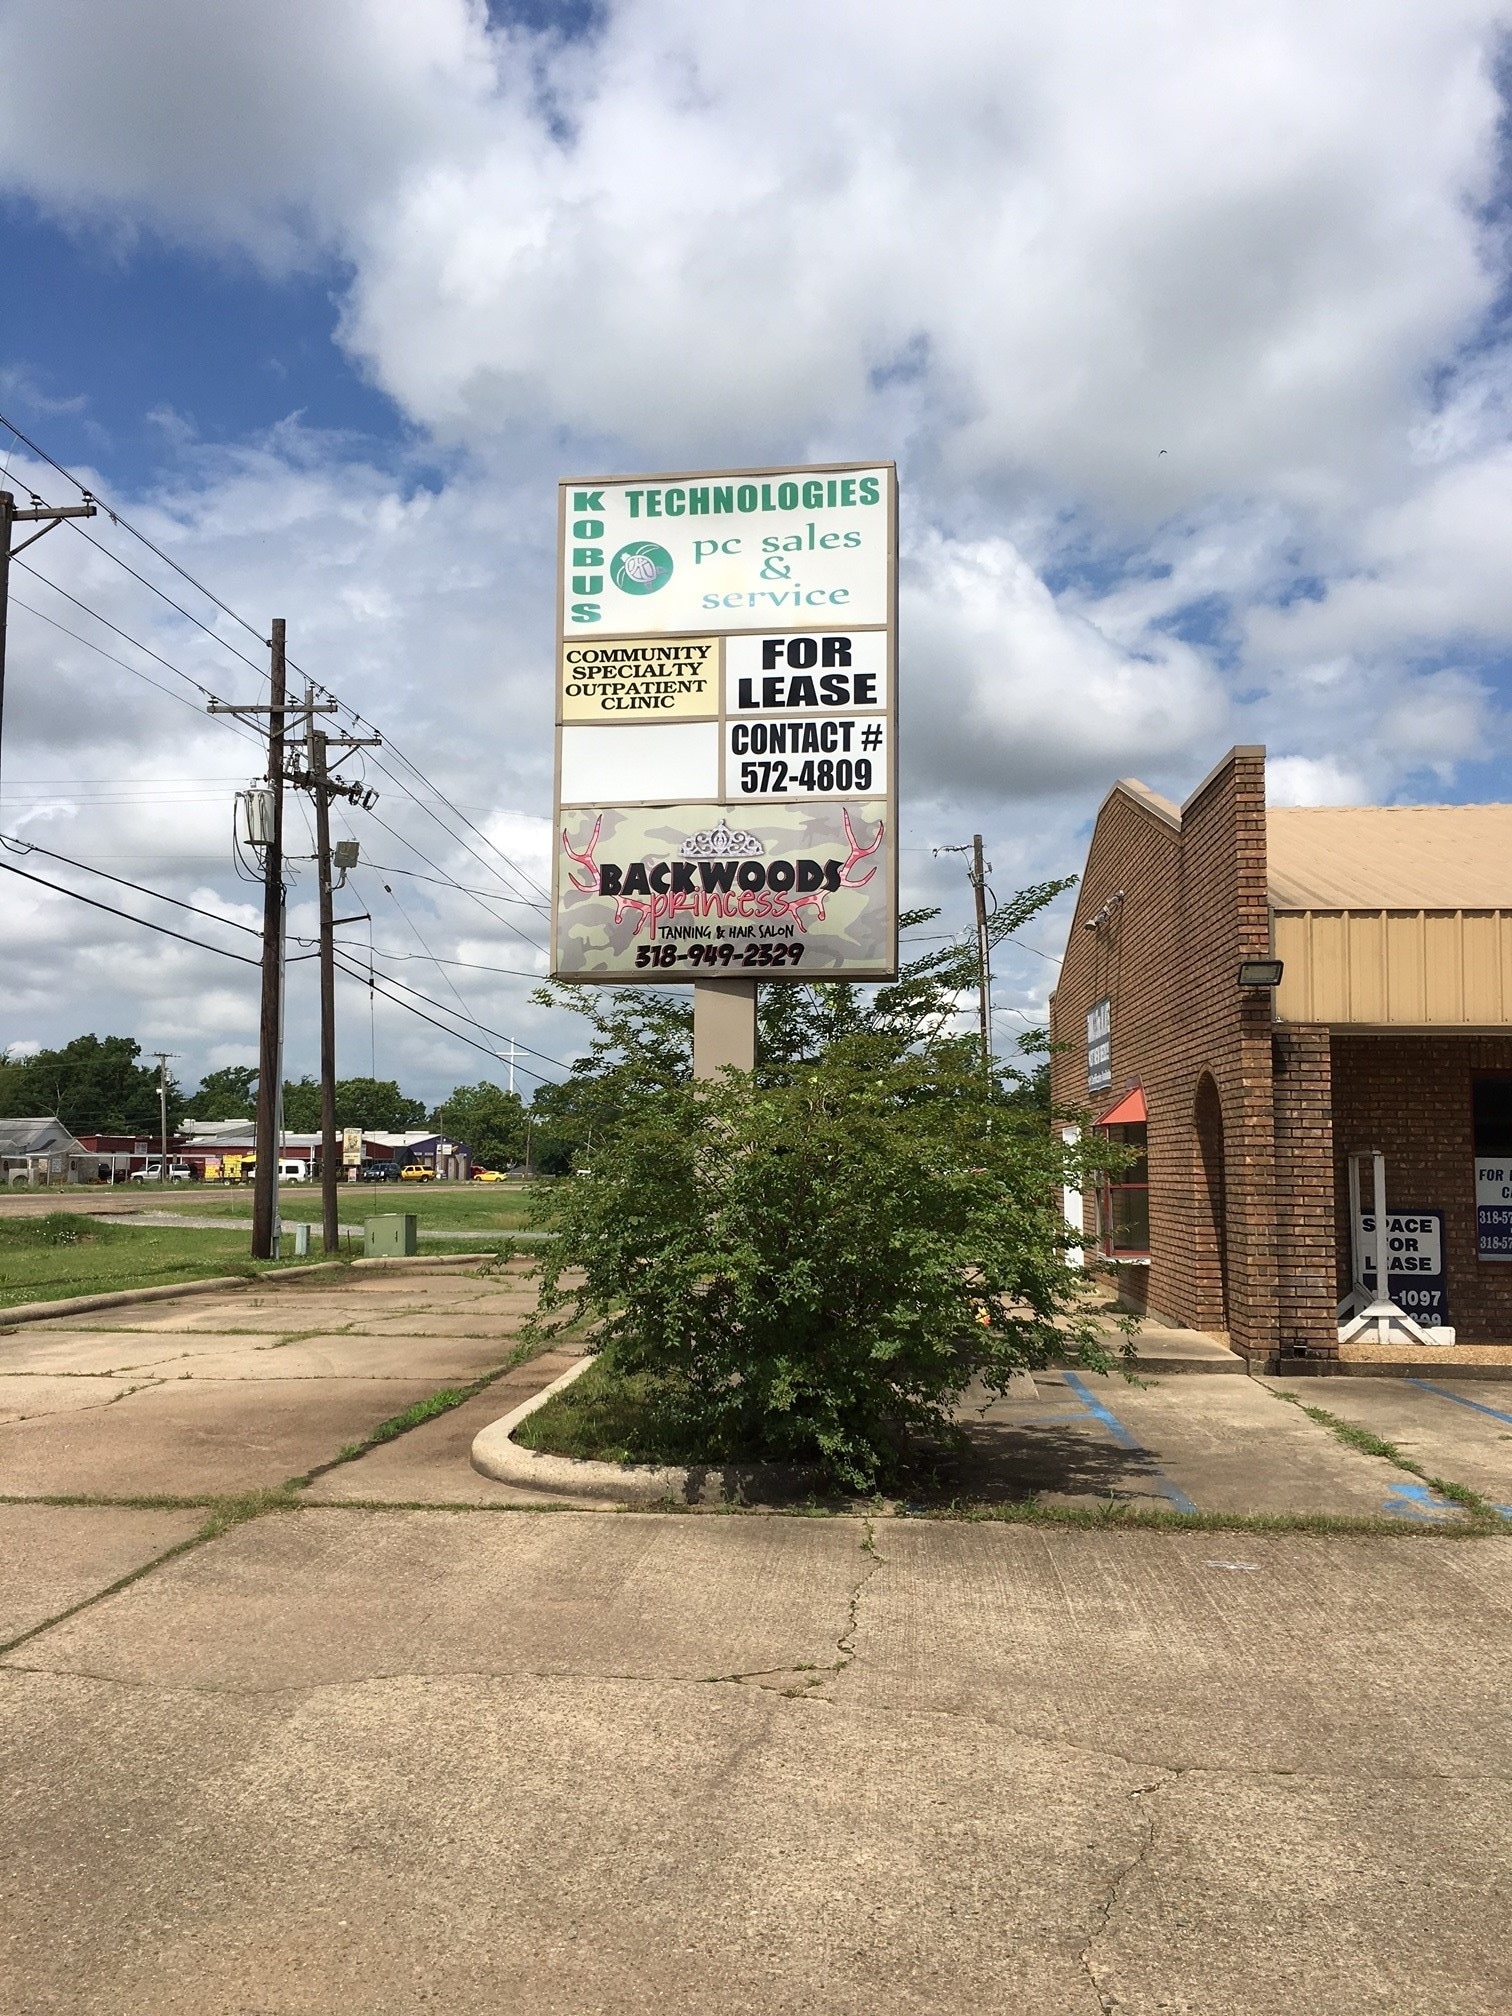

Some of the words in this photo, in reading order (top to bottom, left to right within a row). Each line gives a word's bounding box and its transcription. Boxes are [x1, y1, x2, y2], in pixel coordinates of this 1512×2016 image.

[625, 477, 880, 518] TECHNOLOGIES
[692, 538, 742, 564] pc
[762, 523, 862, 553] sales
[571, 491, 606, 623] KOBUS
[760, 556, 792, 580] &
[702, 583, 850, 609] service
[566, 645, 712, 664] COMMUNITY
[762, 637, 852, 670] FOR
[572, 662, 704, 680] SPECIALTY
[565, 680, 707, 697] OUTPATIENT
[738, 673, 878, 709] LEASE
[601, 696, 675, 710] CLINIC
[731, 721, 855, 755] CONTACT
[861, 724, 883, 752] #
[741, 759, 872, 793] 572-4809
[599, 859, 845, 896] BACKWOODS
[658, 925, 712, 940] TANNING
[716, 927, 725, 939] &
[729, 925, 756, 939] HAIR
[759, 924, 794, 938] SALON
[635, 942, 804, 968] 318-949-2329
[1479, 1169, 1504, 1182] FOR
[1501, 1186, 1512, 1199] C
[1382, 1238, 1419, 1252] OR
[1365, 1257, 1432, 1271] LASE
